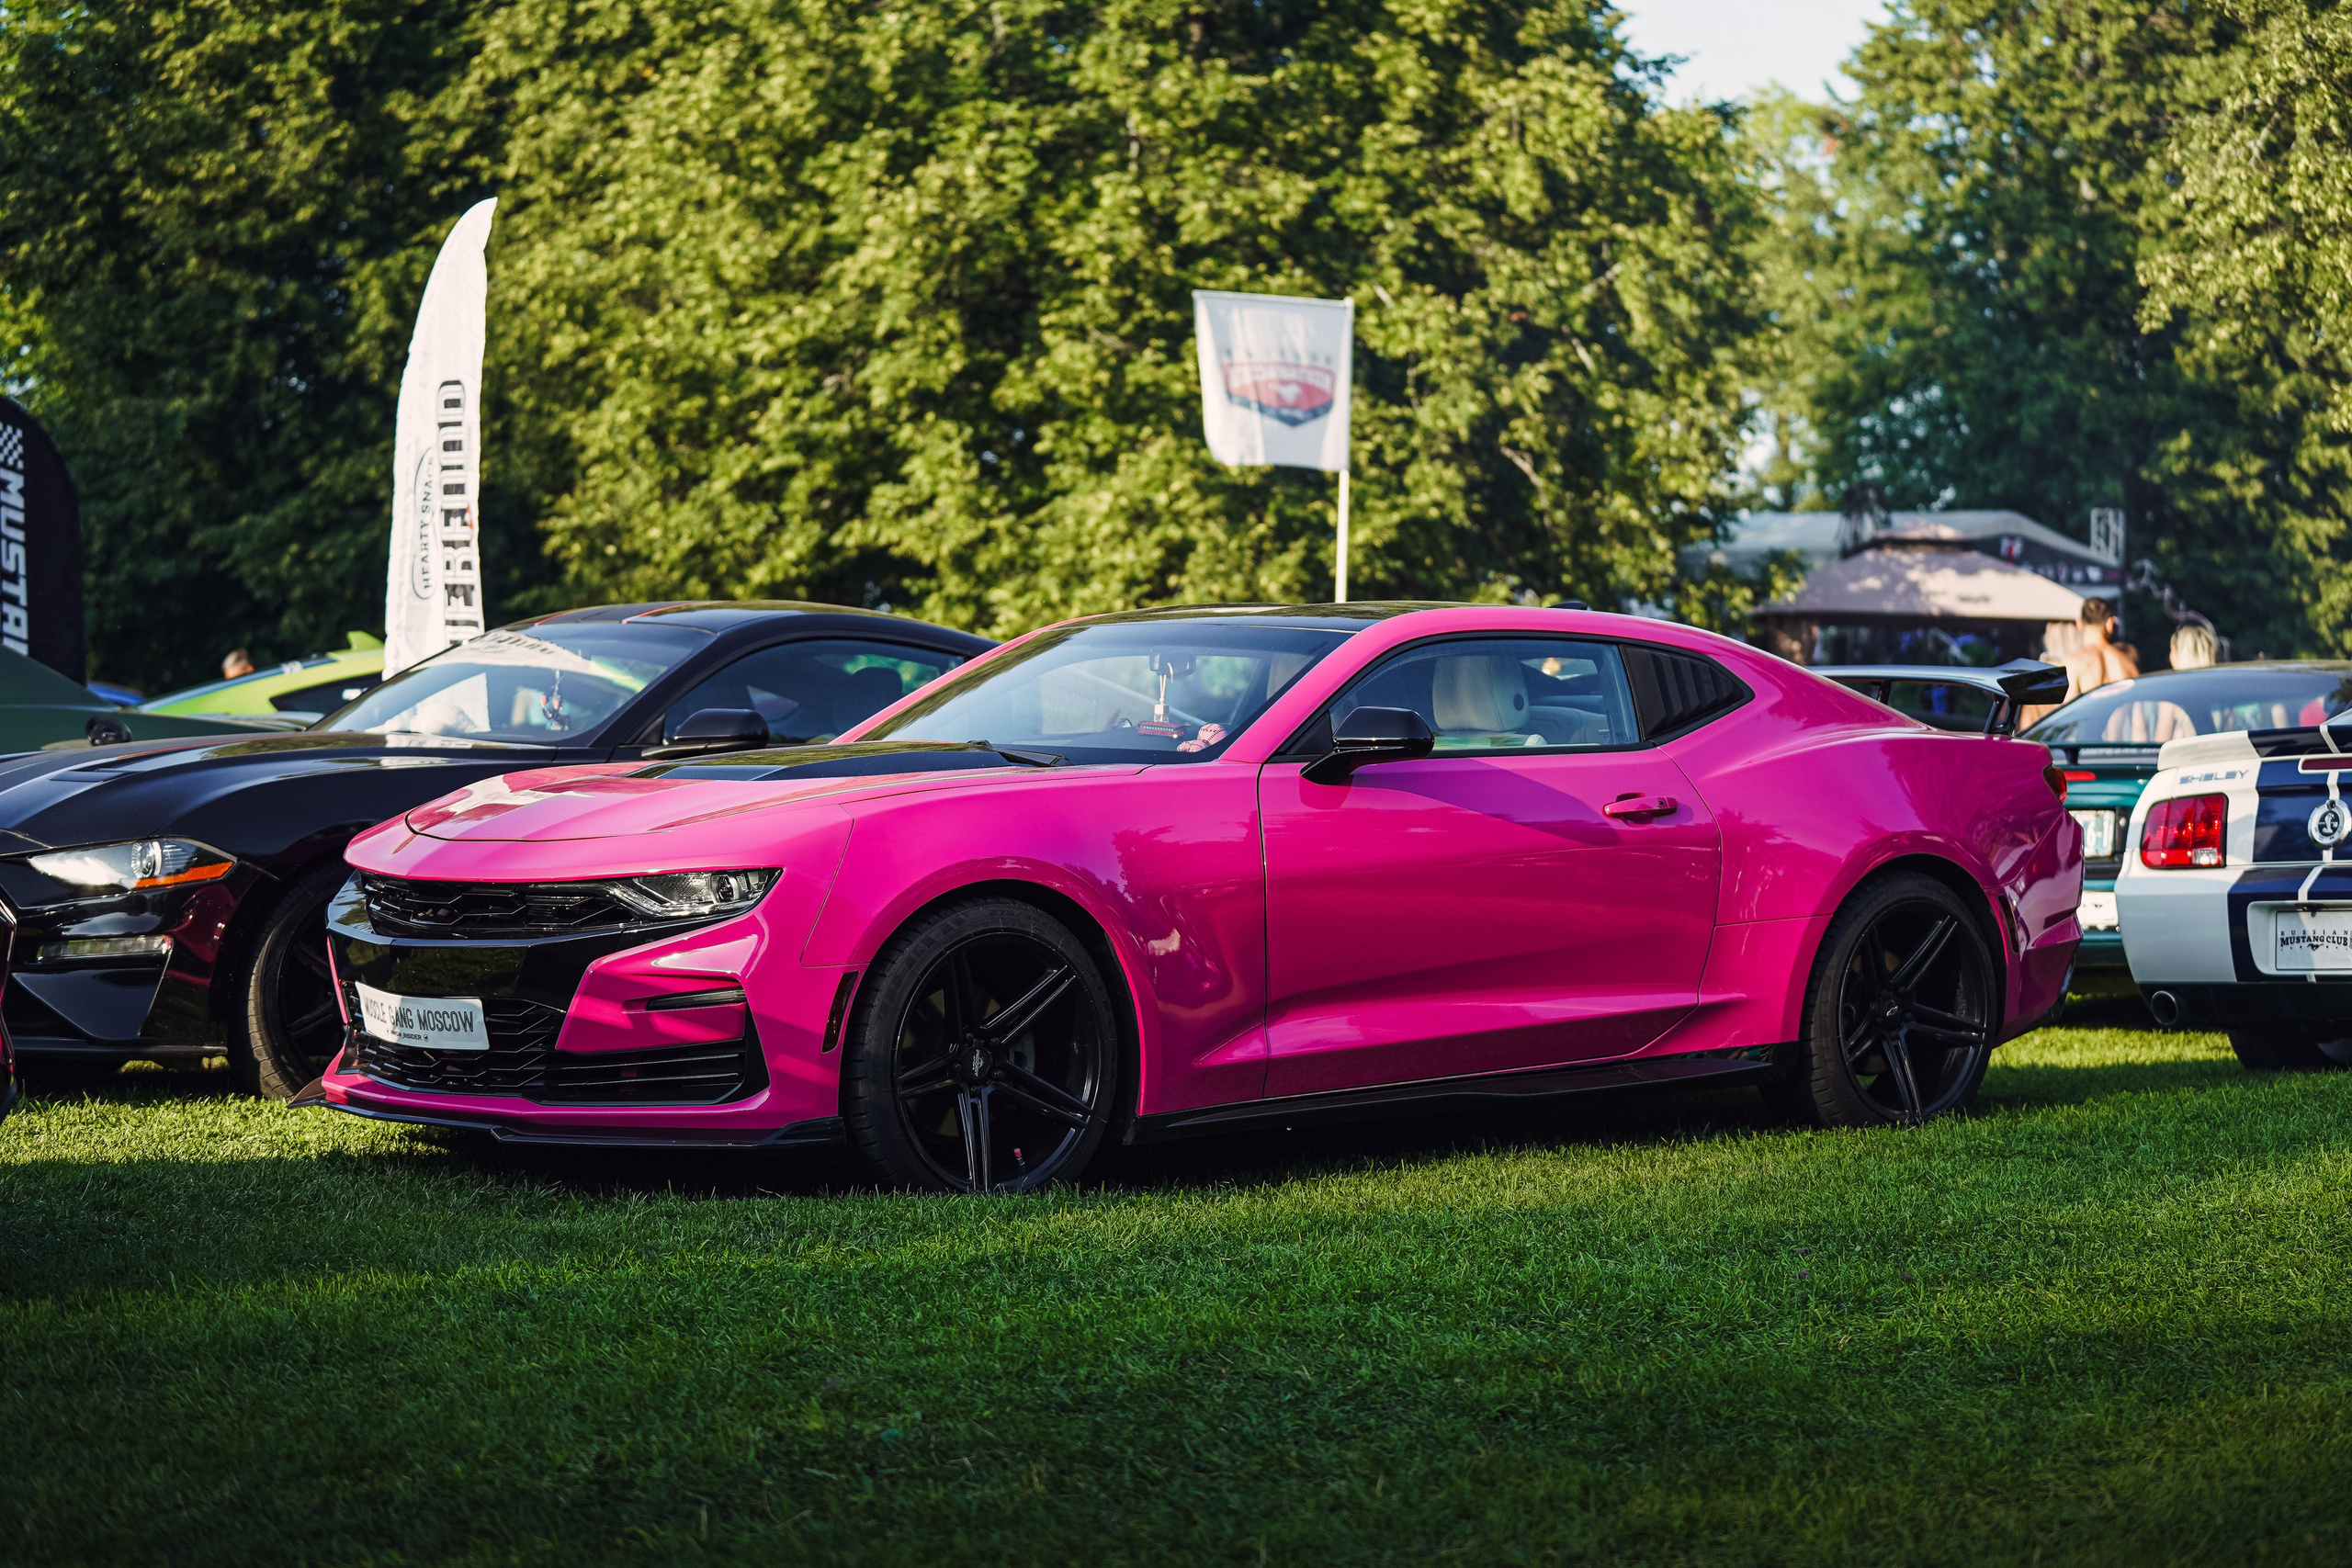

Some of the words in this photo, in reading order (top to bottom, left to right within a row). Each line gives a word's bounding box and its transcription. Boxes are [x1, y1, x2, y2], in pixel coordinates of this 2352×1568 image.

[436, 379, 480, 641] ERFOOD
[420, 521, 433, 590] HEARTY
[2178, 769, 2249, 784] SHELBY
[2279, 936, 2324, 947] MUSTANG
[2325, 936, 2348, 946] CLUB
[389, 1005, 413, 1029] GANG
[416, 1009, 474, 1032] MOSCOW
